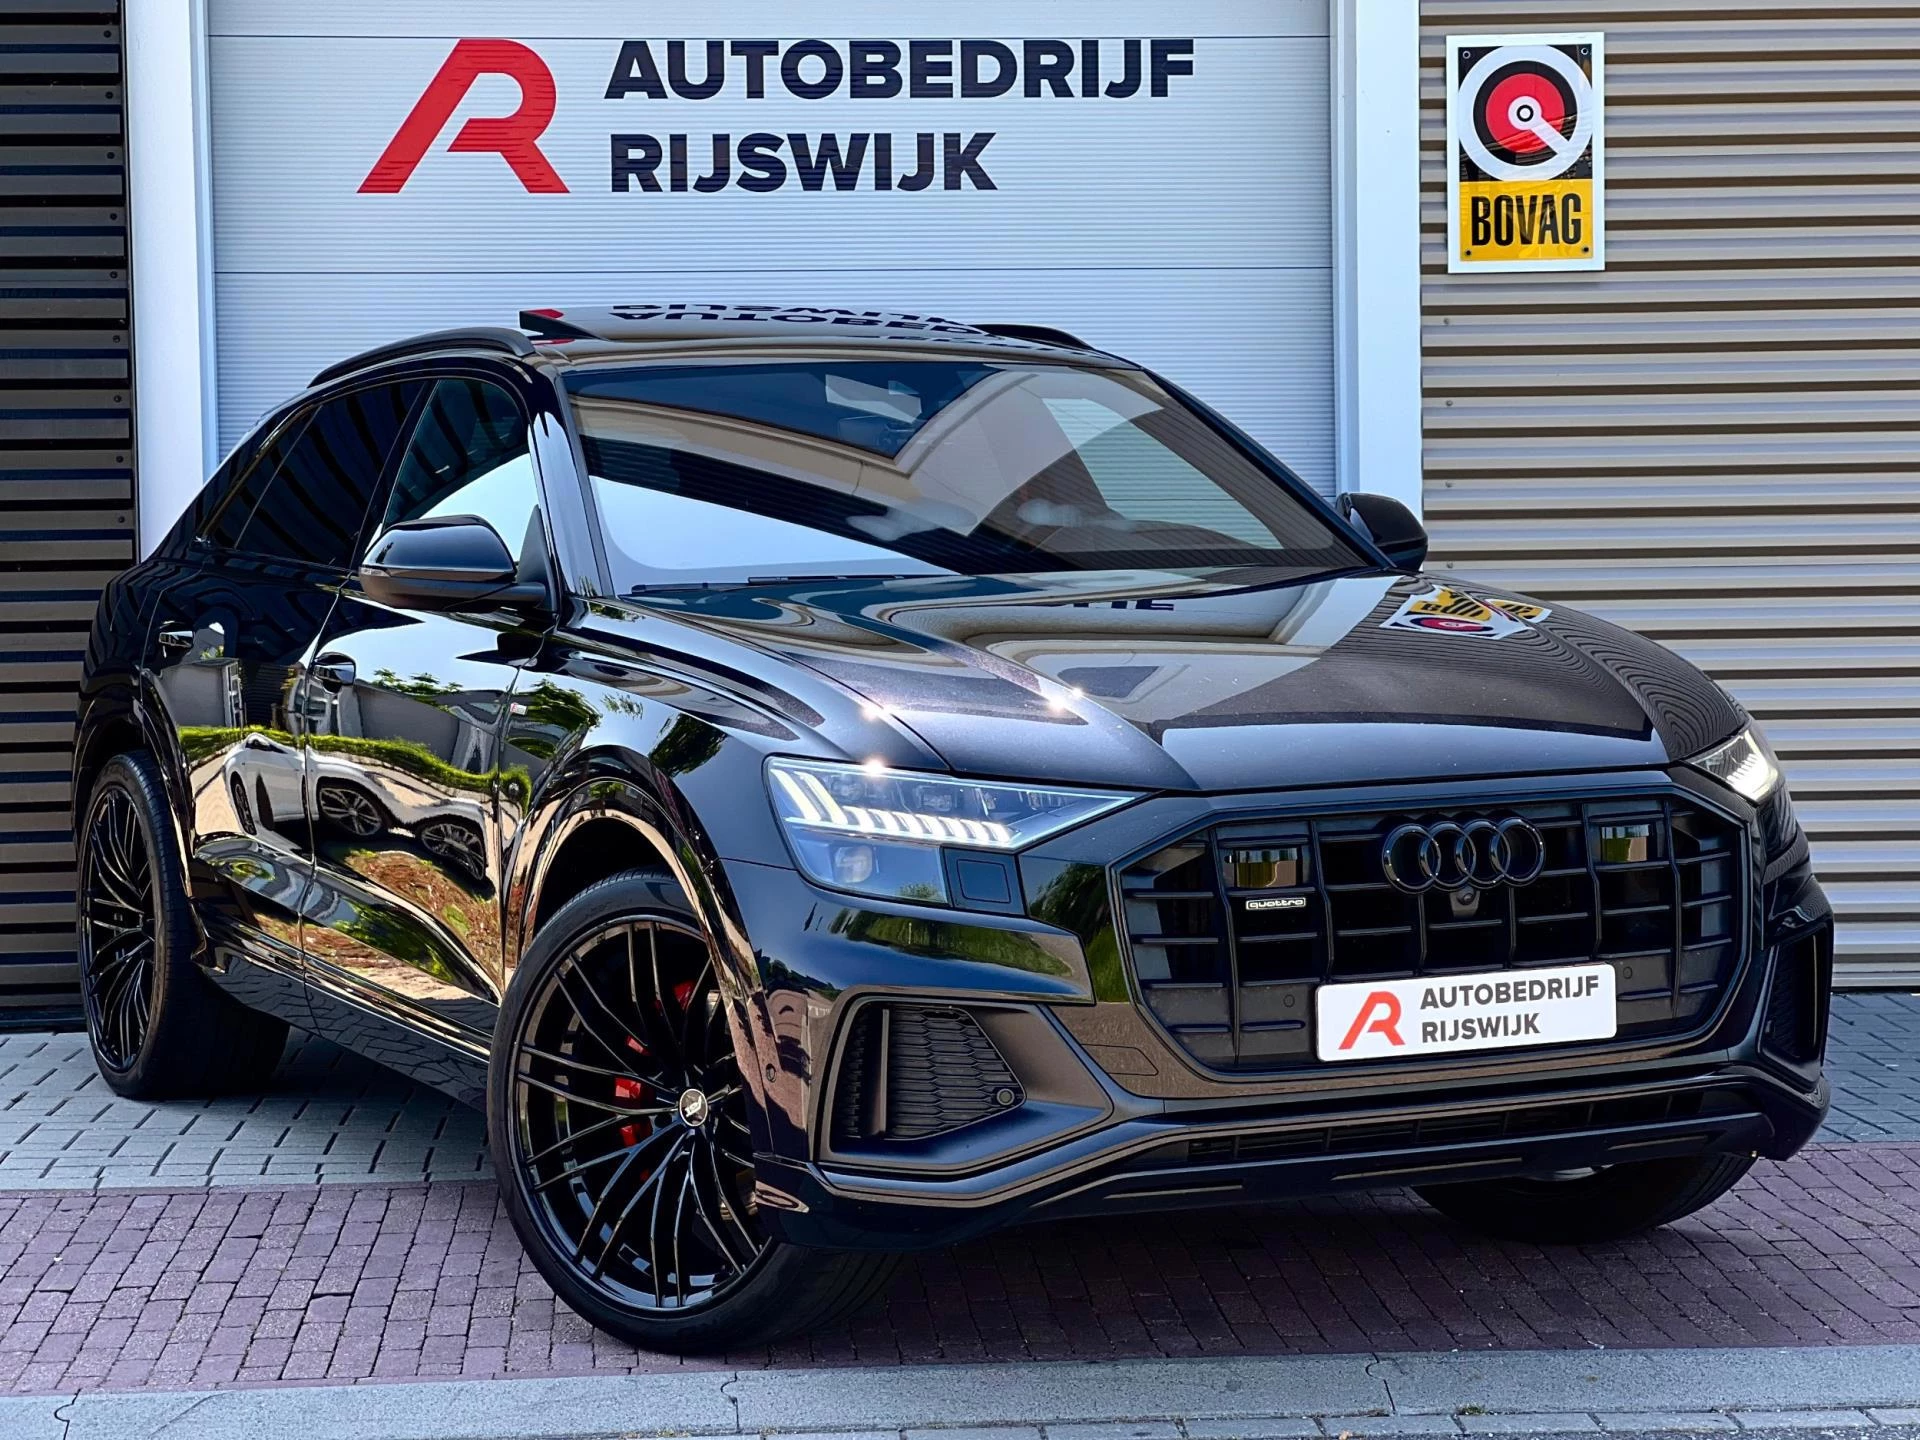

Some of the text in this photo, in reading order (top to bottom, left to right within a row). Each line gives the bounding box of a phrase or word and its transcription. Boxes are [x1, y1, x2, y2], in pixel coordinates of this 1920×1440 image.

[604, 39, 1194, 99] AUTOBEDRIJF
[611, 132, 998, 192] RIJSWIJK
[1471, 193, 1582, 246] BOVAG
[1249, 899, 1304, 909] quattro
[1420, 975, 1599, 1010] AUTOBEDRIJF
[1422, 1013, 1540, 1043] RIJSWIJK
